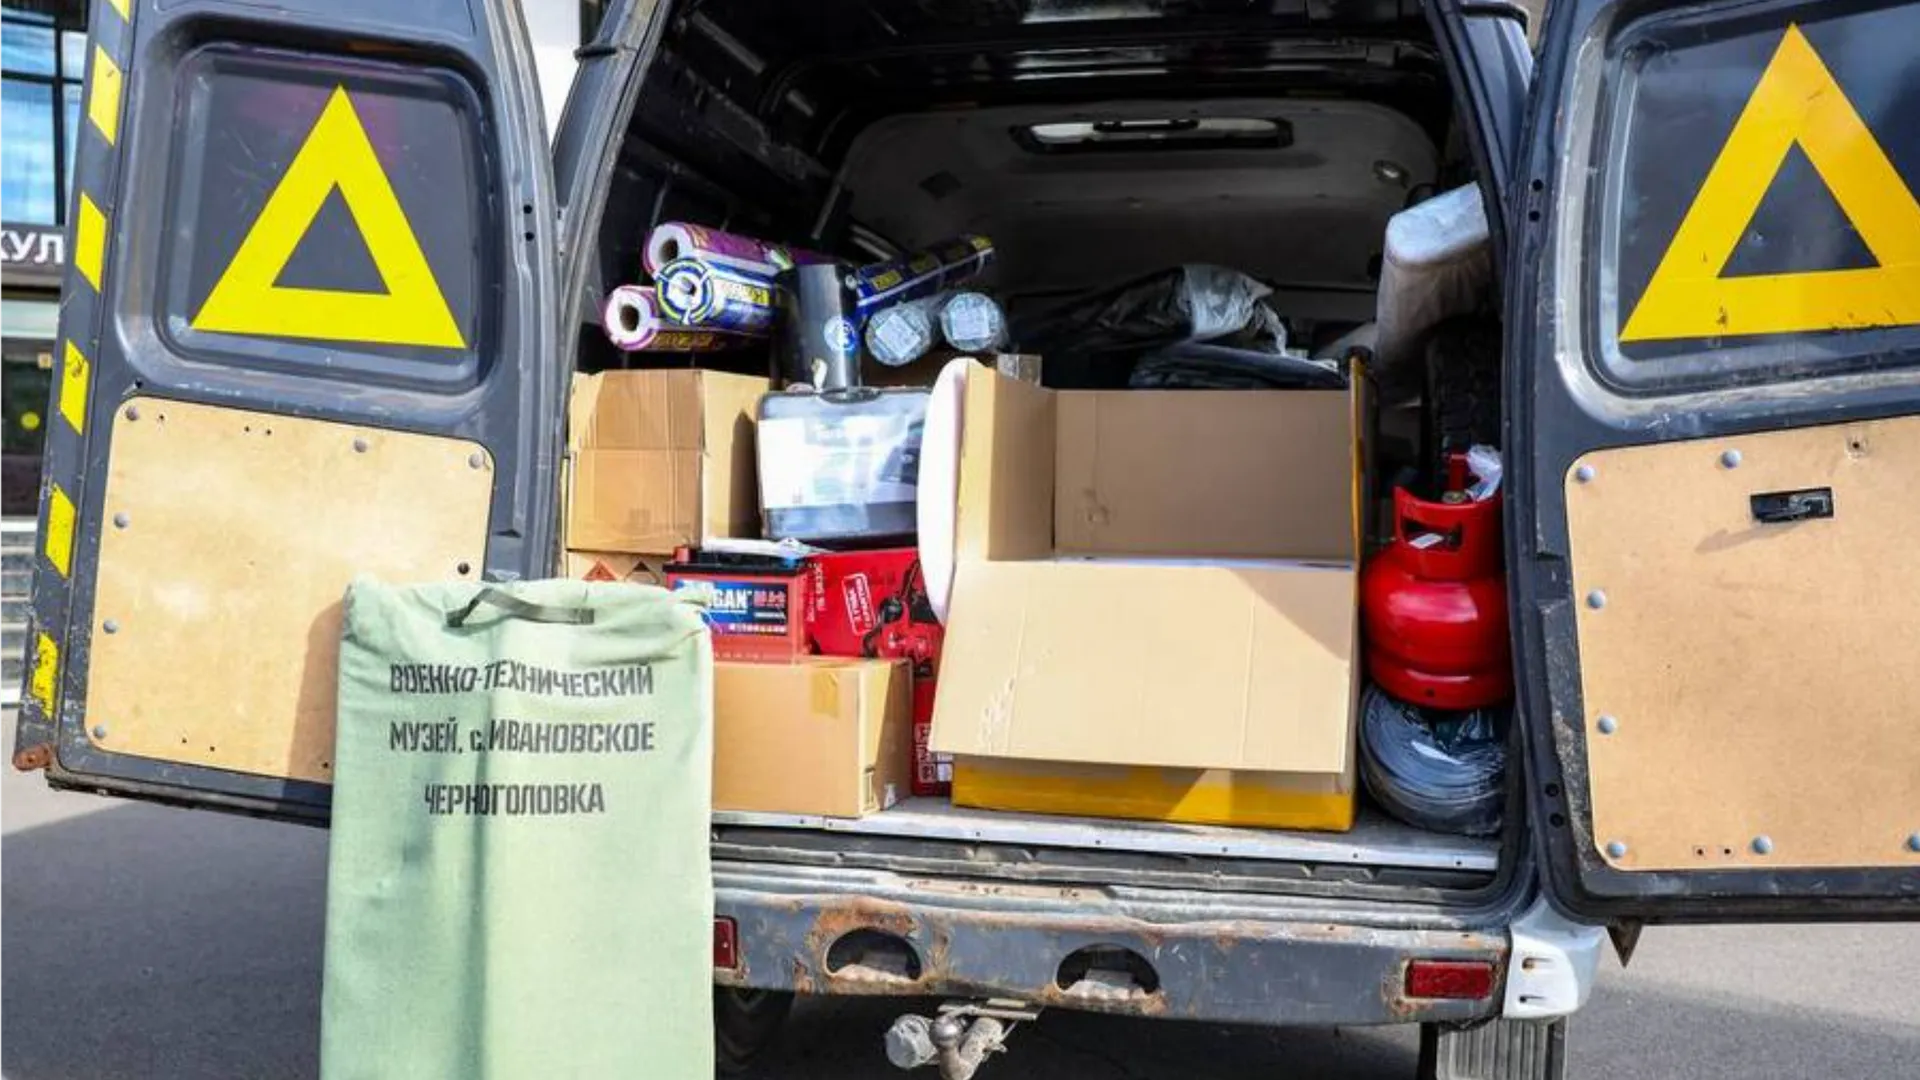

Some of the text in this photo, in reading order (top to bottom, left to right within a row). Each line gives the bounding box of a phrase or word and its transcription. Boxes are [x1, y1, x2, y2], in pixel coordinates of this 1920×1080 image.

[709, 588, 748, 609] GAN
[390, 660, 654, 697] ВОЕННО-ТЕХНИЧЕСКИЙ
[489, 719, 655, 752] ИВАНОВСКОЕ
[425, 783, 605, 816] ЧЕРНОГОЛОВКА
